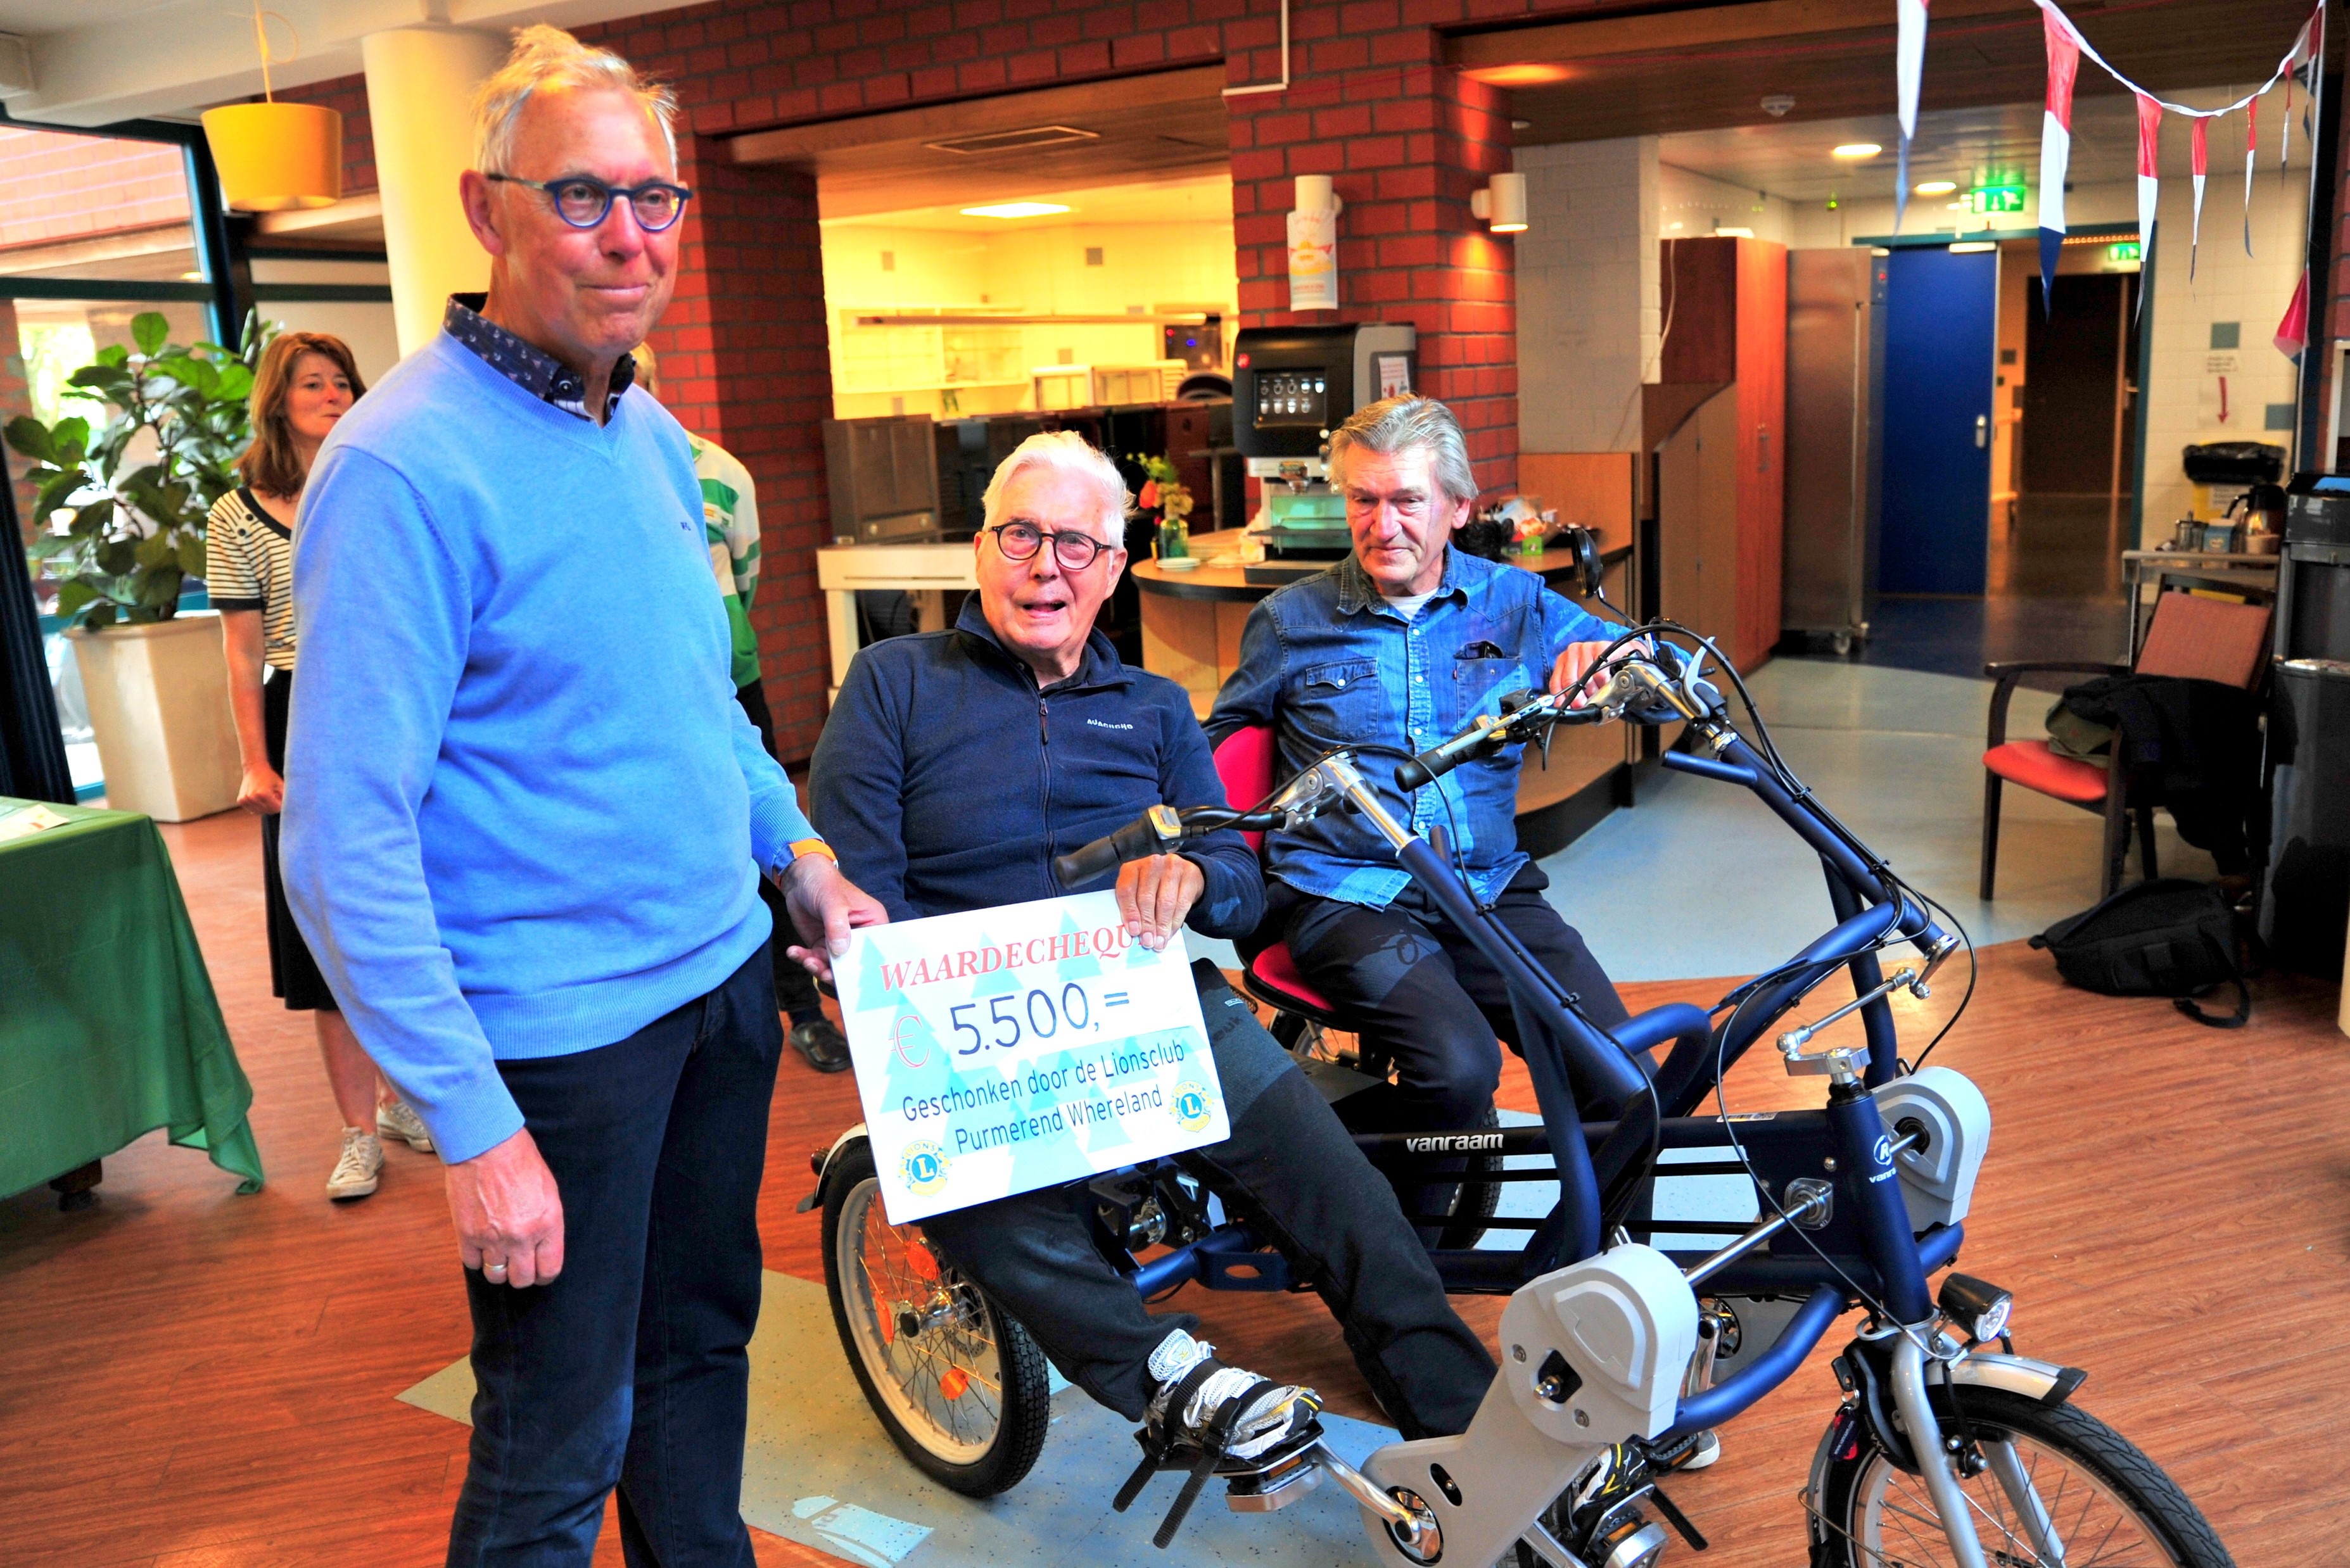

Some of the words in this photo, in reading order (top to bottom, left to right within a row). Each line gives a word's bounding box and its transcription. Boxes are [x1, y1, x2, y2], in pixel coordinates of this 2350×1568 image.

[880, 924, 1144, 992] WAARDECHEQU
[903, 1079, 1022, 1122] Geschonken
[1027, 1059, 1068, 1095] door
[1076, 1060, 1097, 1084] de
[1101, 1039, 1185, 1078] Lionsclub
[1174, 1082, 1201, 1096] LIONS
[1183, 1096, 1201, 1116] L
[955, 1107, 1064, 1154] Purmerend
[1067, 1084, 1163, 1127] Whereland
[905, 1142, 936, 1157] LIONS
[1406, 1133, 1504, 1153] vanraam
[915, 1157, 936, 1179] L
